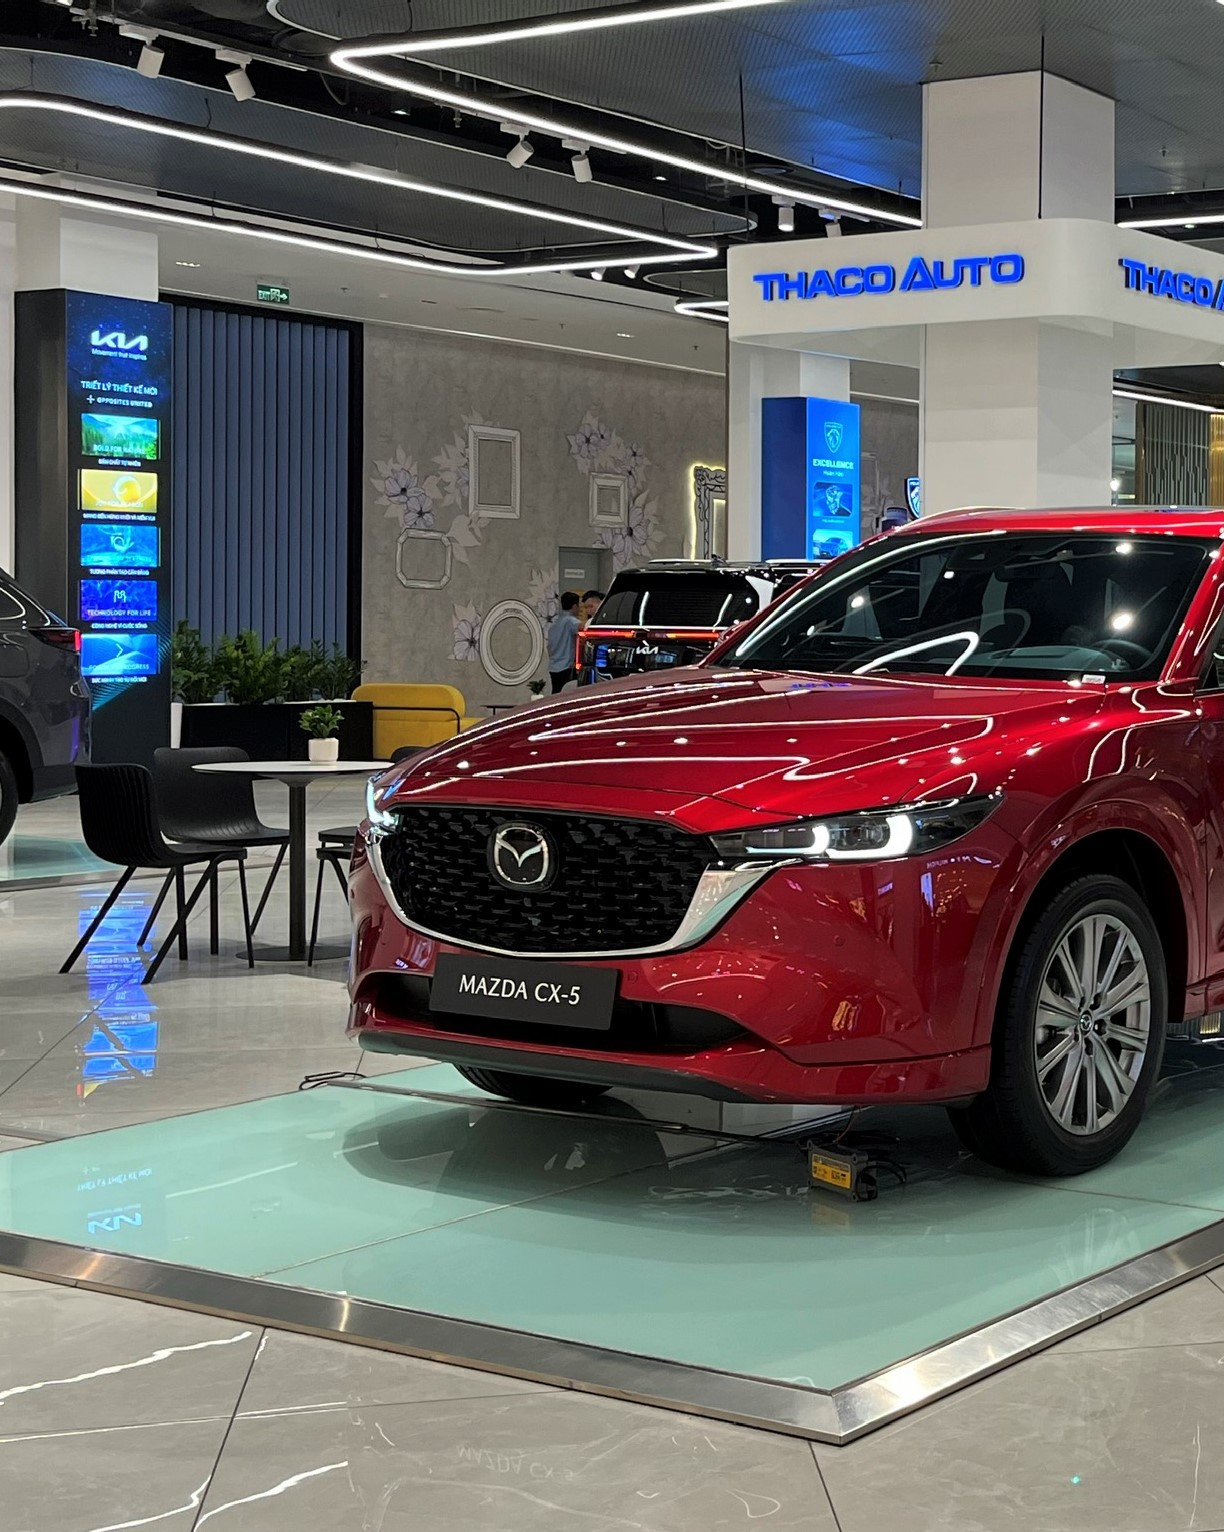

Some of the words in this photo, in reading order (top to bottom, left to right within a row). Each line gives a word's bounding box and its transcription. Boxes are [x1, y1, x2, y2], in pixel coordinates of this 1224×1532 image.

[753, 264, 896, 301] THACO
[899, 254, 1025, 291] AUTO
[1118, 258, 1214, 307] THACO
[91, 330, 149, 351] KIA
[80, 380, 102, 390] TRIẾT
[112, 383, 133, 394] THIẾT
[96, 397, 130, 406] OPPOSITES
[813, 458, 854, 470] EXCELLENCE
[87, 609, 126, 617] TECHNOLOGY
[126, 609, 139, 617] FOR
[139, 609, 151, 617] LIFE
[636, 645, 659, 655] KIA
[458, 974, 529, 1000] MAZDA
[534, 982, 581, 1005] CX-5
